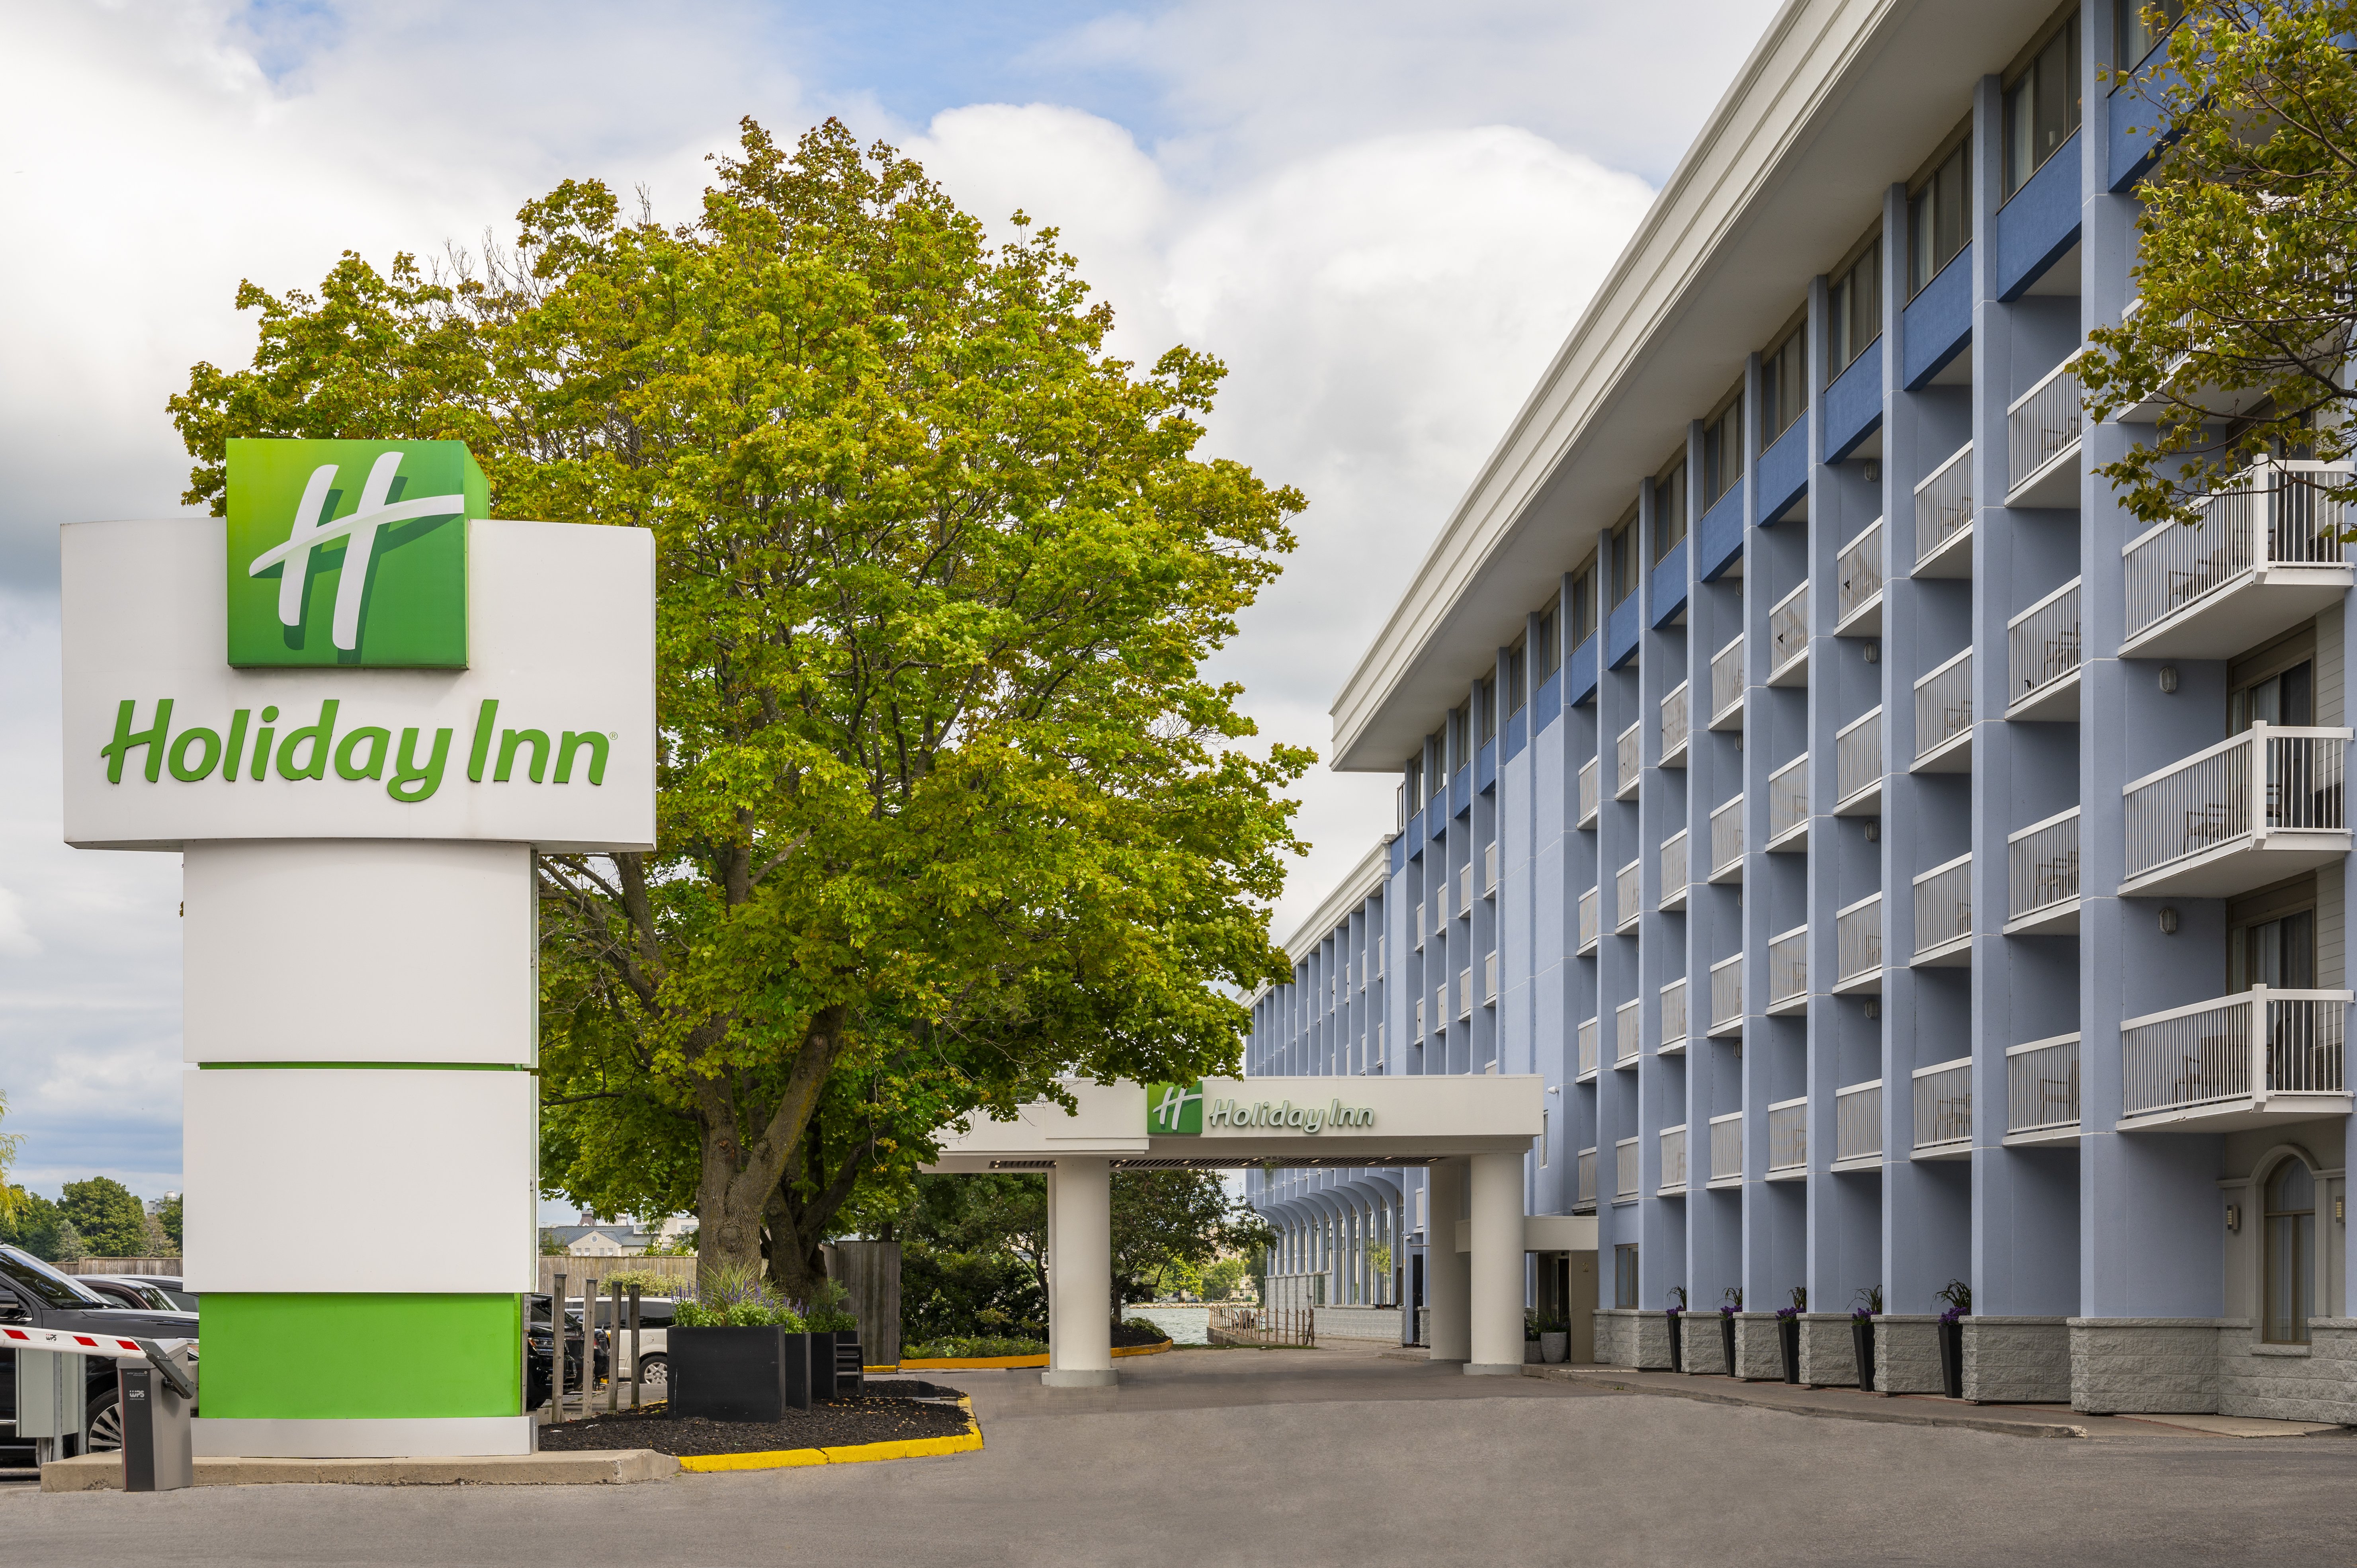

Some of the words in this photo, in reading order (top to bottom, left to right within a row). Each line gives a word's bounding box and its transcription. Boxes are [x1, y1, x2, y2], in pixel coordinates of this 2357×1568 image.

[100, 698, 453, 802] Holiday
[1209, 1099, 1325, 1133] Holiday
[1328, 1099, 1374, 1126] Inn
[1582, 1262, 1589, 1272] 2
